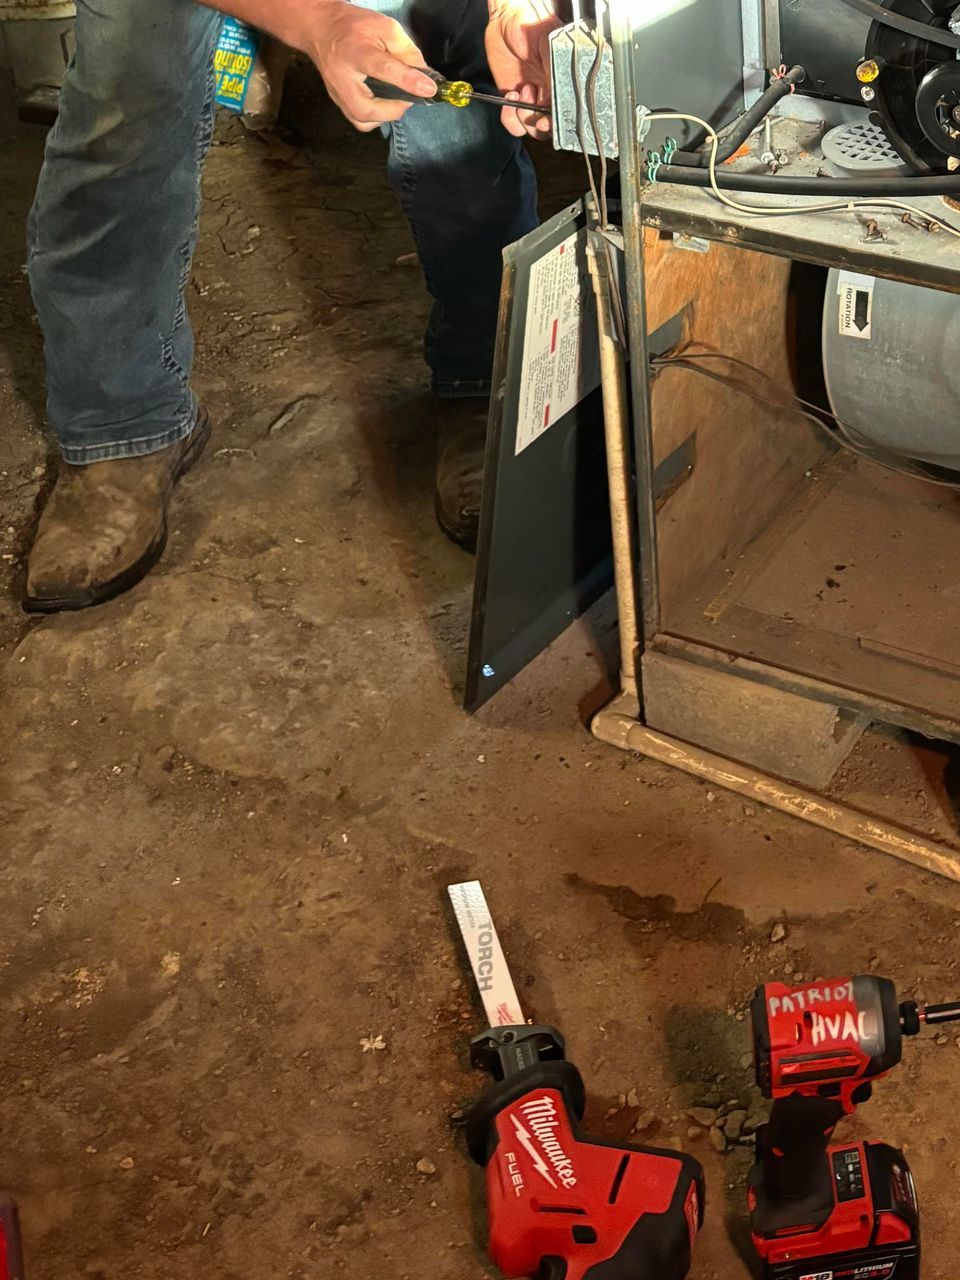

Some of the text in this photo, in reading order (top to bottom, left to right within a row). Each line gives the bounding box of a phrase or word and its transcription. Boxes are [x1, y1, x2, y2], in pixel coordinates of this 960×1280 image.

[221, 75, 245, 95] PIPE
[845, 287, 853, 329] ROTATION
[478, 922, 494, 992] TORCH
[768, 981, 854, 1017] PATRIOT
[811, 1011, 867, 1047] HVAC
[519, 1095, 577, 1190] Milwaukee
[504, 1152, 525, 1198] FUEL
